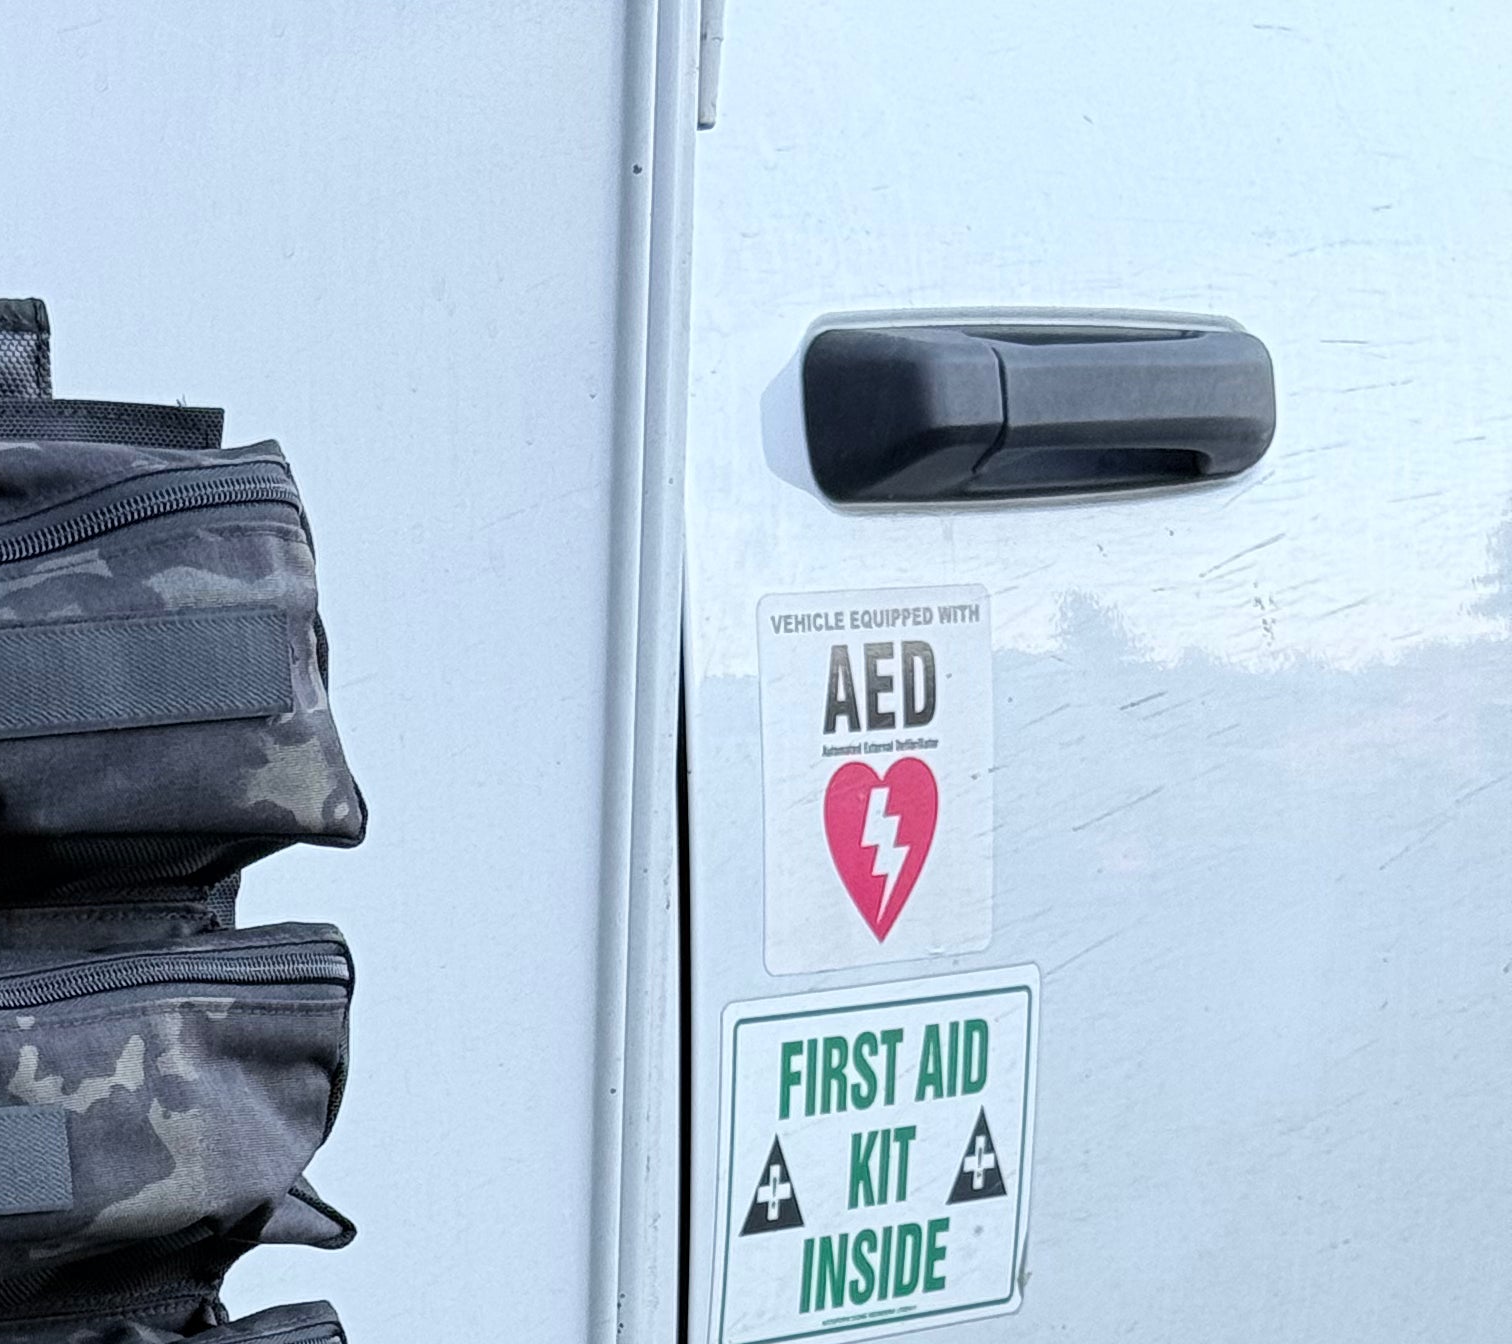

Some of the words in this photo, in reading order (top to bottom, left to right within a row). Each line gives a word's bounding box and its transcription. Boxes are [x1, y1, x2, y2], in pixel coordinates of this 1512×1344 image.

[771, 611, 845, 634] VEHICLE
[850, 607, 933, 630] EQUIPPED
[938, 604, 981, 625] WITH
[822, 640, 937, 735] AED
[778, 1028, 904, 1121] FIRST
[915, 1018, 989, 1102] AID
[848, 1125, 917, 1210] KIT
[799, 1217, 950, 1314] INSIDE
